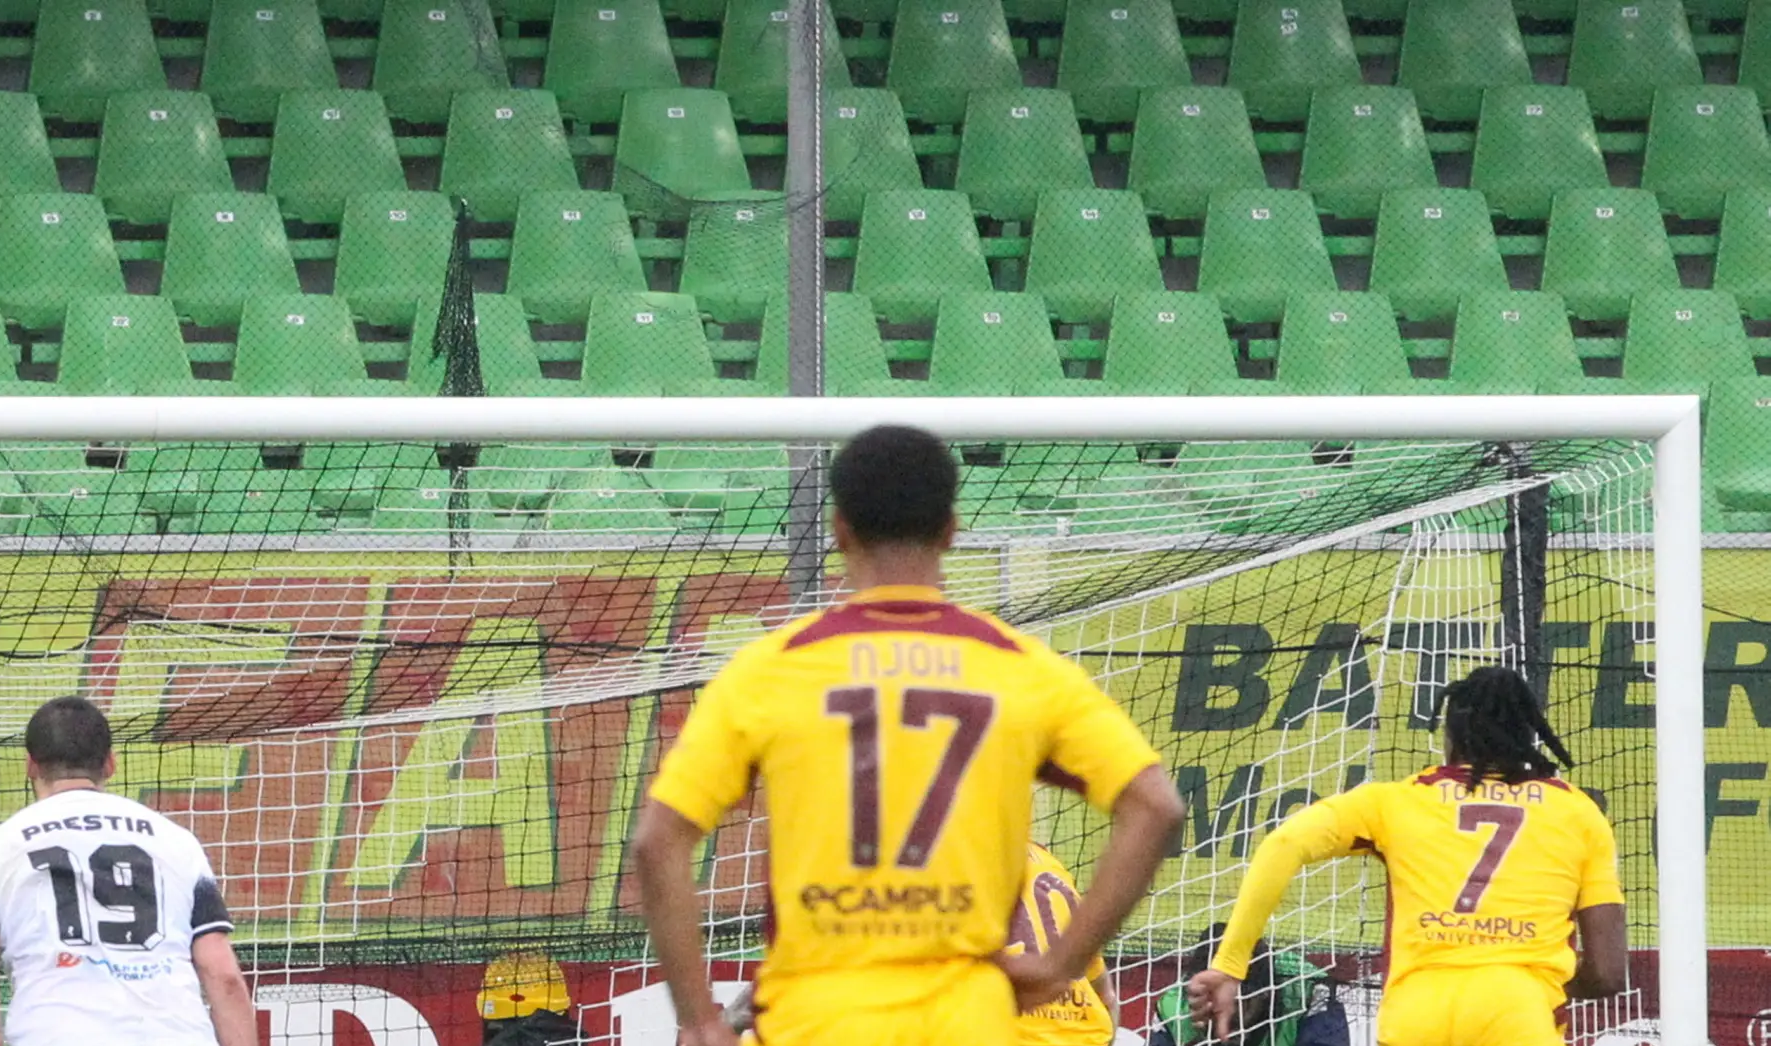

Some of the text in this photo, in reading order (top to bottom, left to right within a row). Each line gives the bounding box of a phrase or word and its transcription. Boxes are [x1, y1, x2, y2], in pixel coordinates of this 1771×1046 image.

[850, 641, 963, 678] NJOH
[822, 685, 996, 871] 17
[1438, 780, 1544, 803] TONGYA
[21, 814, 155, 842] PRESTIA
[1452, 803, 1526, 915] 7
[26, 843, 166, 952] 19
